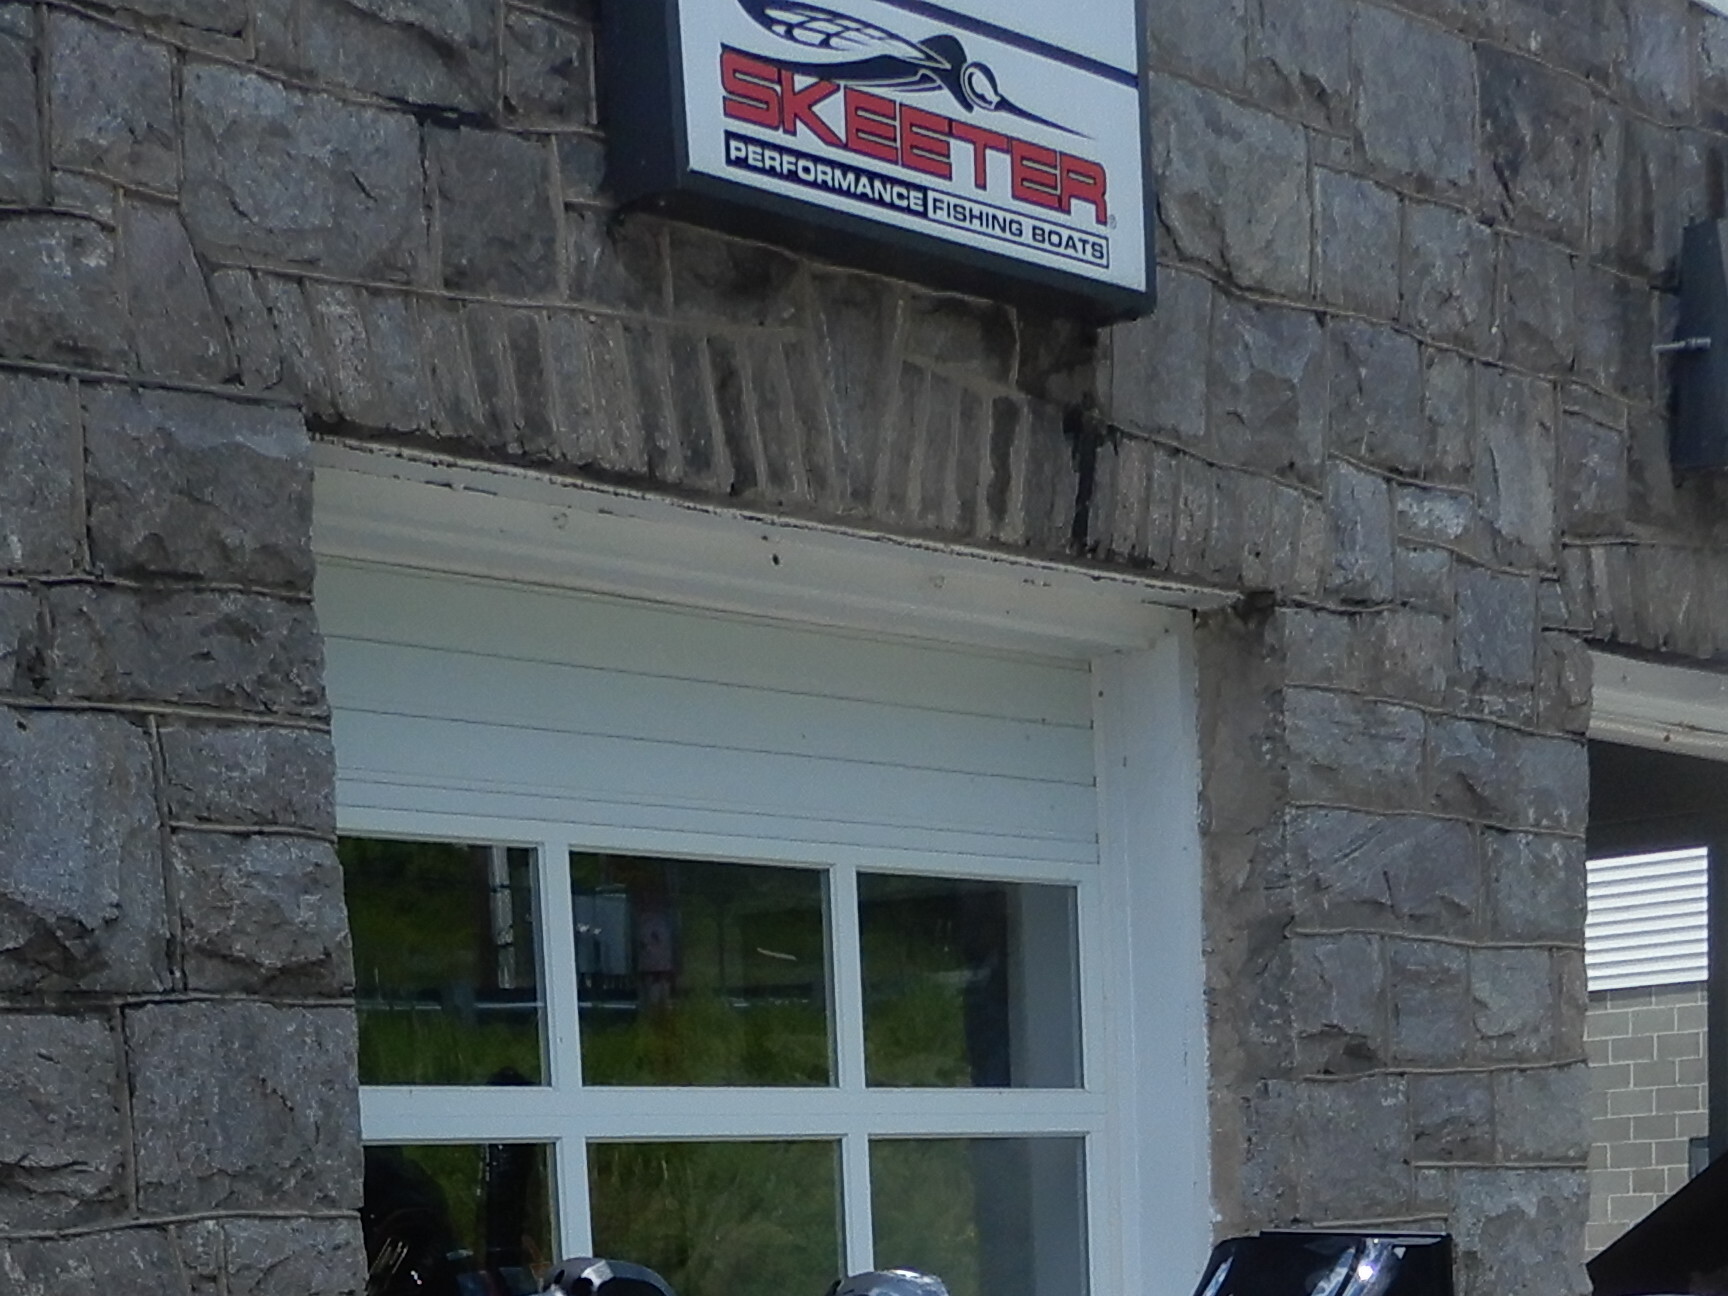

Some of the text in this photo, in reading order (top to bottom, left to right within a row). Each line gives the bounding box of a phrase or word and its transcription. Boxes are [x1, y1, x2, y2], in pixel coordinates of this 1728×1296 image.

[720, 44, 1109, 226] SKEETER
[728, 140, 1106, 261] PERFORMANCE FISHING BOATS
